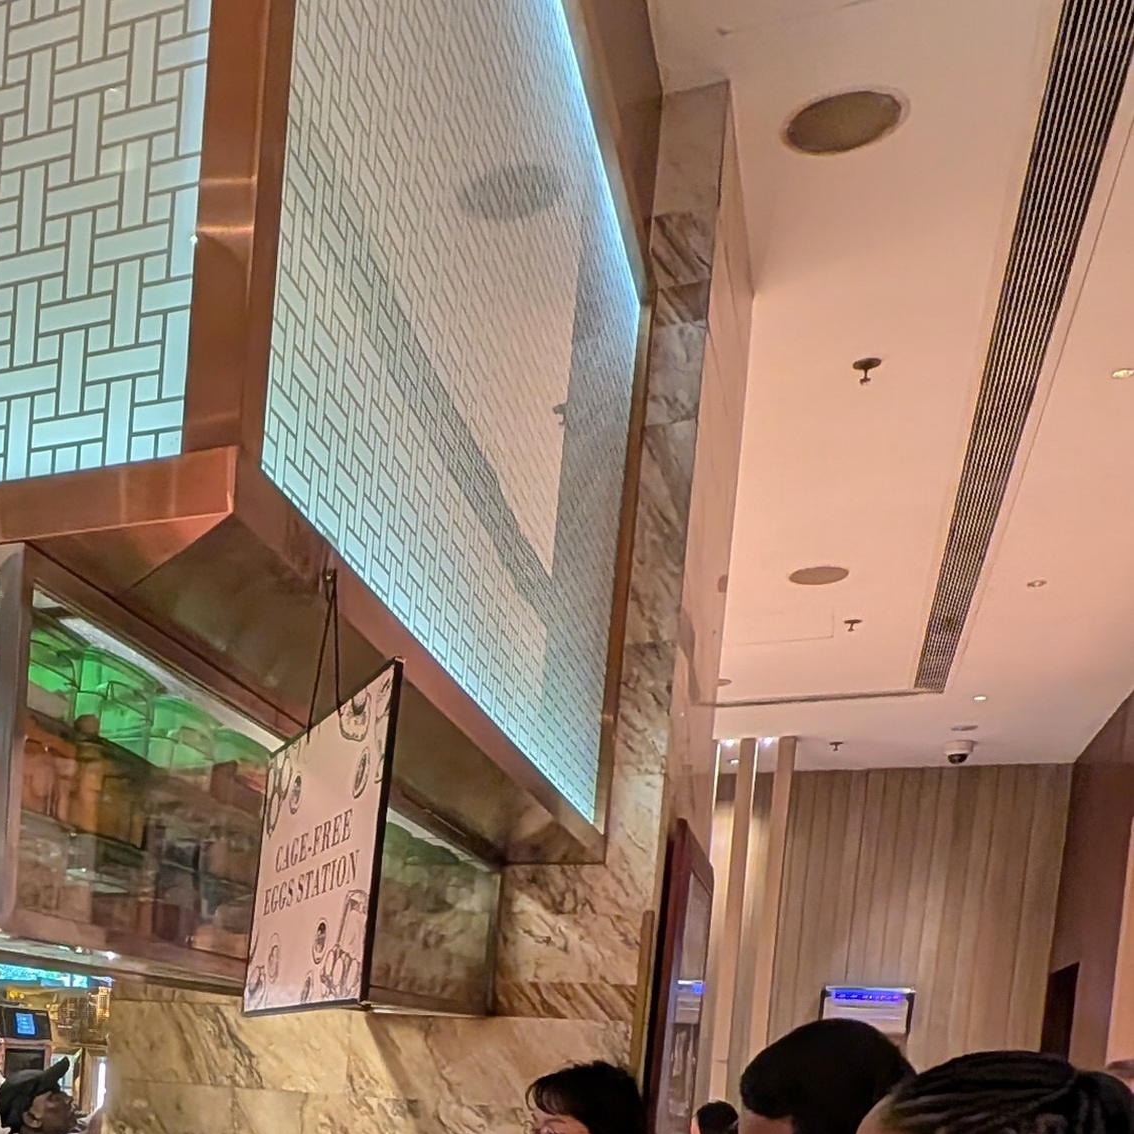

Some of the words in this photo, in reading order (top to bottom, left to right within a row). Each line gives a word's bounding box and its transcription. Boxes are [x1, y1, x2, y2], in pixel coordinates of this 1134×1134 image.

[275, 808, 353, 873] CAGE-FREE
[263, 878, 295, 916] EGGS
[296, 849, 360, 904] STATION
